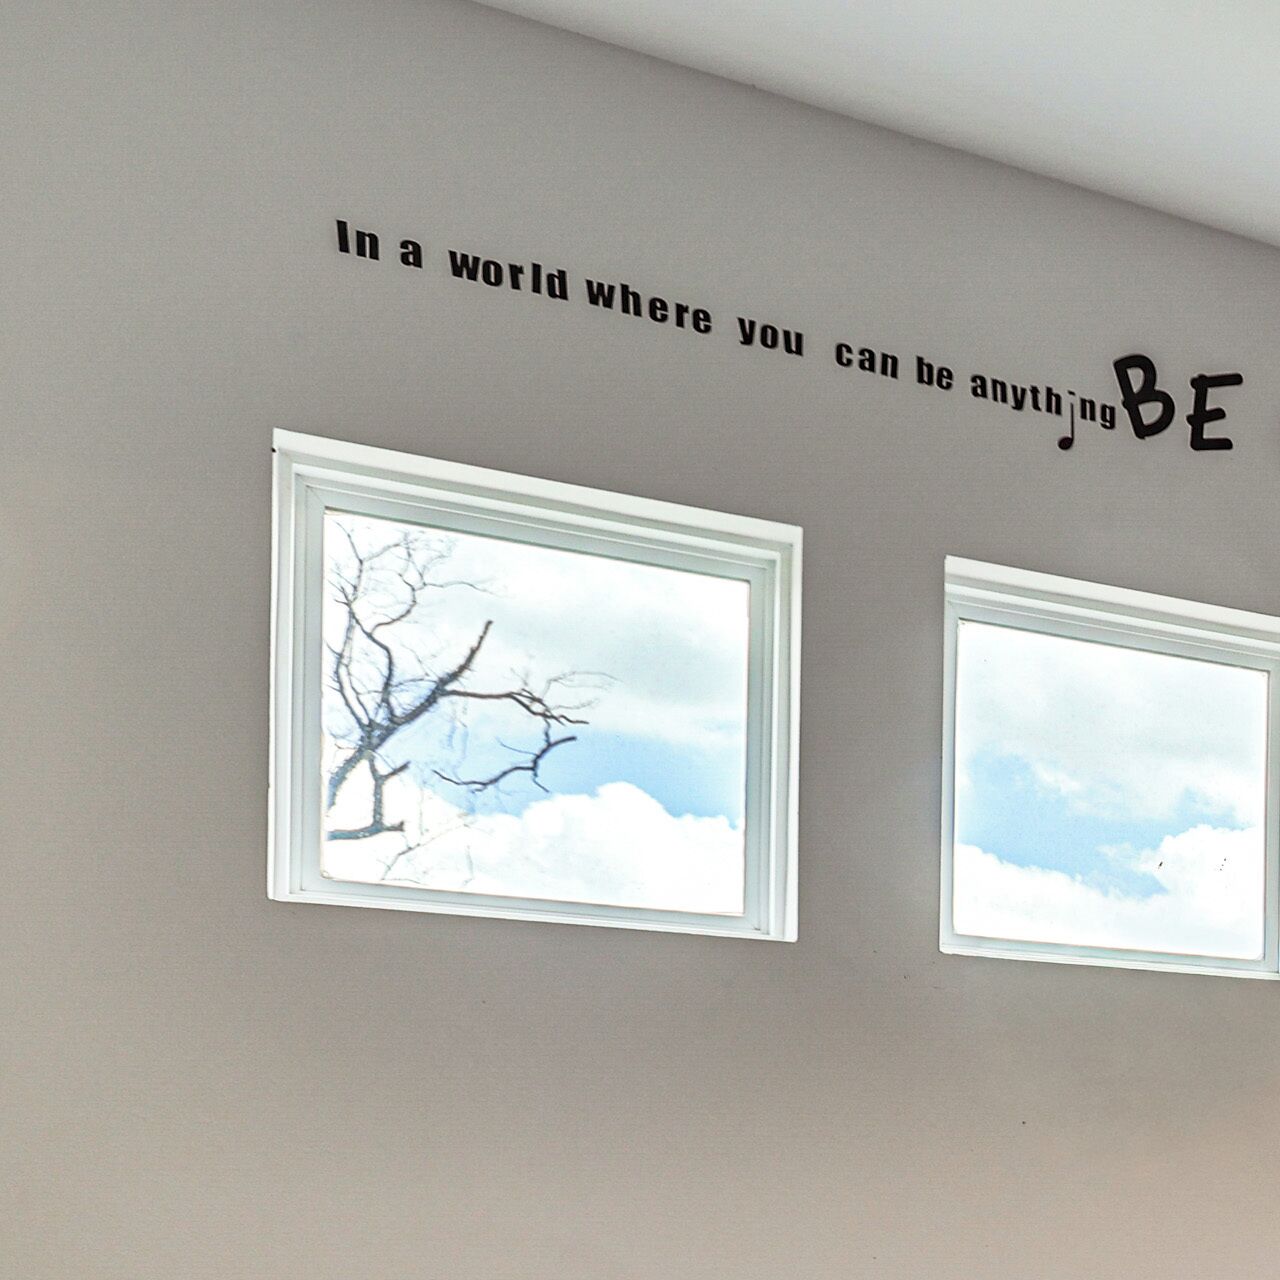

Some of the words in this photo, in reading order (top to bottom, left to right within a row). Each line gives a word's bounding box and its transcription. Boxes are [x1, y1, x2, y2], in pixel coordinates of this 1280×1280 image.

[335, 219, 381, 262] In
[399, 239, 423, 269] a
[447, 249, 569, 301] world
[585, 278, 713, 335] where
[737, 316, 804, 357] you
[835, 342, 899, 380] can
[915, 355, 954, 391] be
[970, 374, 1117, 451] anything
[1112, 353, 1244, 452] BE
